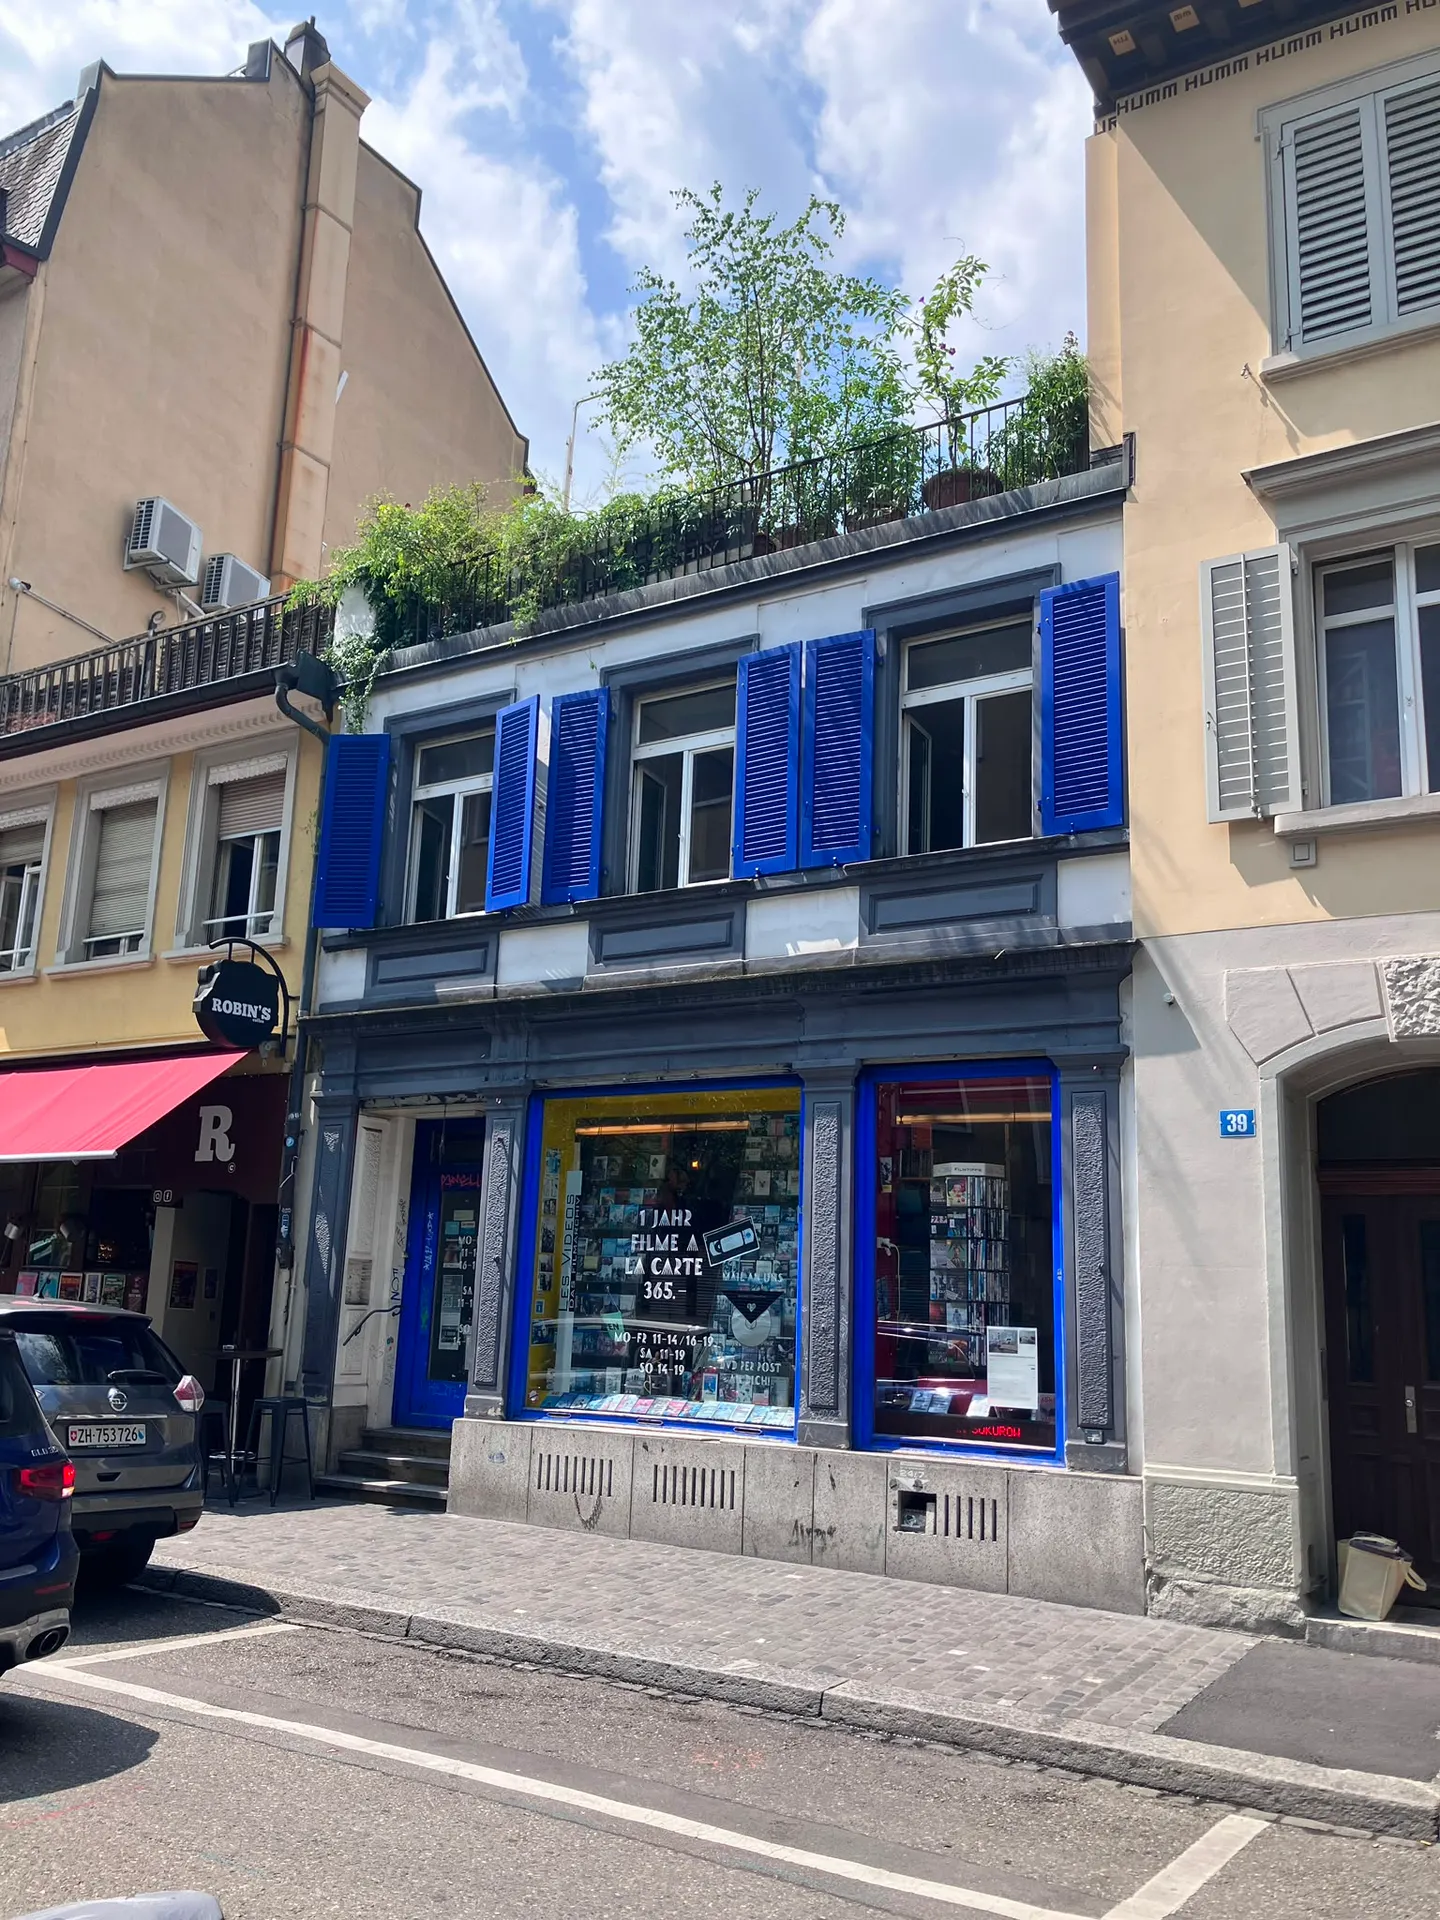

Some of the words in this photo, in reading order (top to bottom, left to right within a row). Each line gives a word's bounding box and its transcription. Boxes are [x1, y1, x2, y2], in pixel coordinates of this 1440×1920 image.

[1116, 82, 1178, 116] HUMM
[1184, 55, 1249, 92] HUMM
[1256, 30, 1322, 66] HUMM
[1329, 5, 1398, 39] HUMM
[211, 997, 271, 1021] ROBIN'S
[1226, 1113, 1248, 1132] 39
[194, 1104, 236, 1162] R
[639, 1209, 646, 1227] 1
[651, 1209, 693, 1229] JAHR
[560, 1194, 575, 1266] VIDEOS
[630, 1233, 679, 1252] FILME
[686, 1234, 699, 1252] A
[625, 1257, 646, 1275] LA
[650, 1257, 703, 1276] CARTE
[462, 1285, 473, 1295] SA
[558, 1275, 570, 1312] LES
[614, 1331, 648, 1344] MO-FR
[640, 1347, 652, 1360] SA
[660, 1349, 686, 1361] 11-19
[639, 1363, 654, 1374] SO
[657, 1363, 685, 1376] 14-19
[757, 1362, 782, 1373] POST
